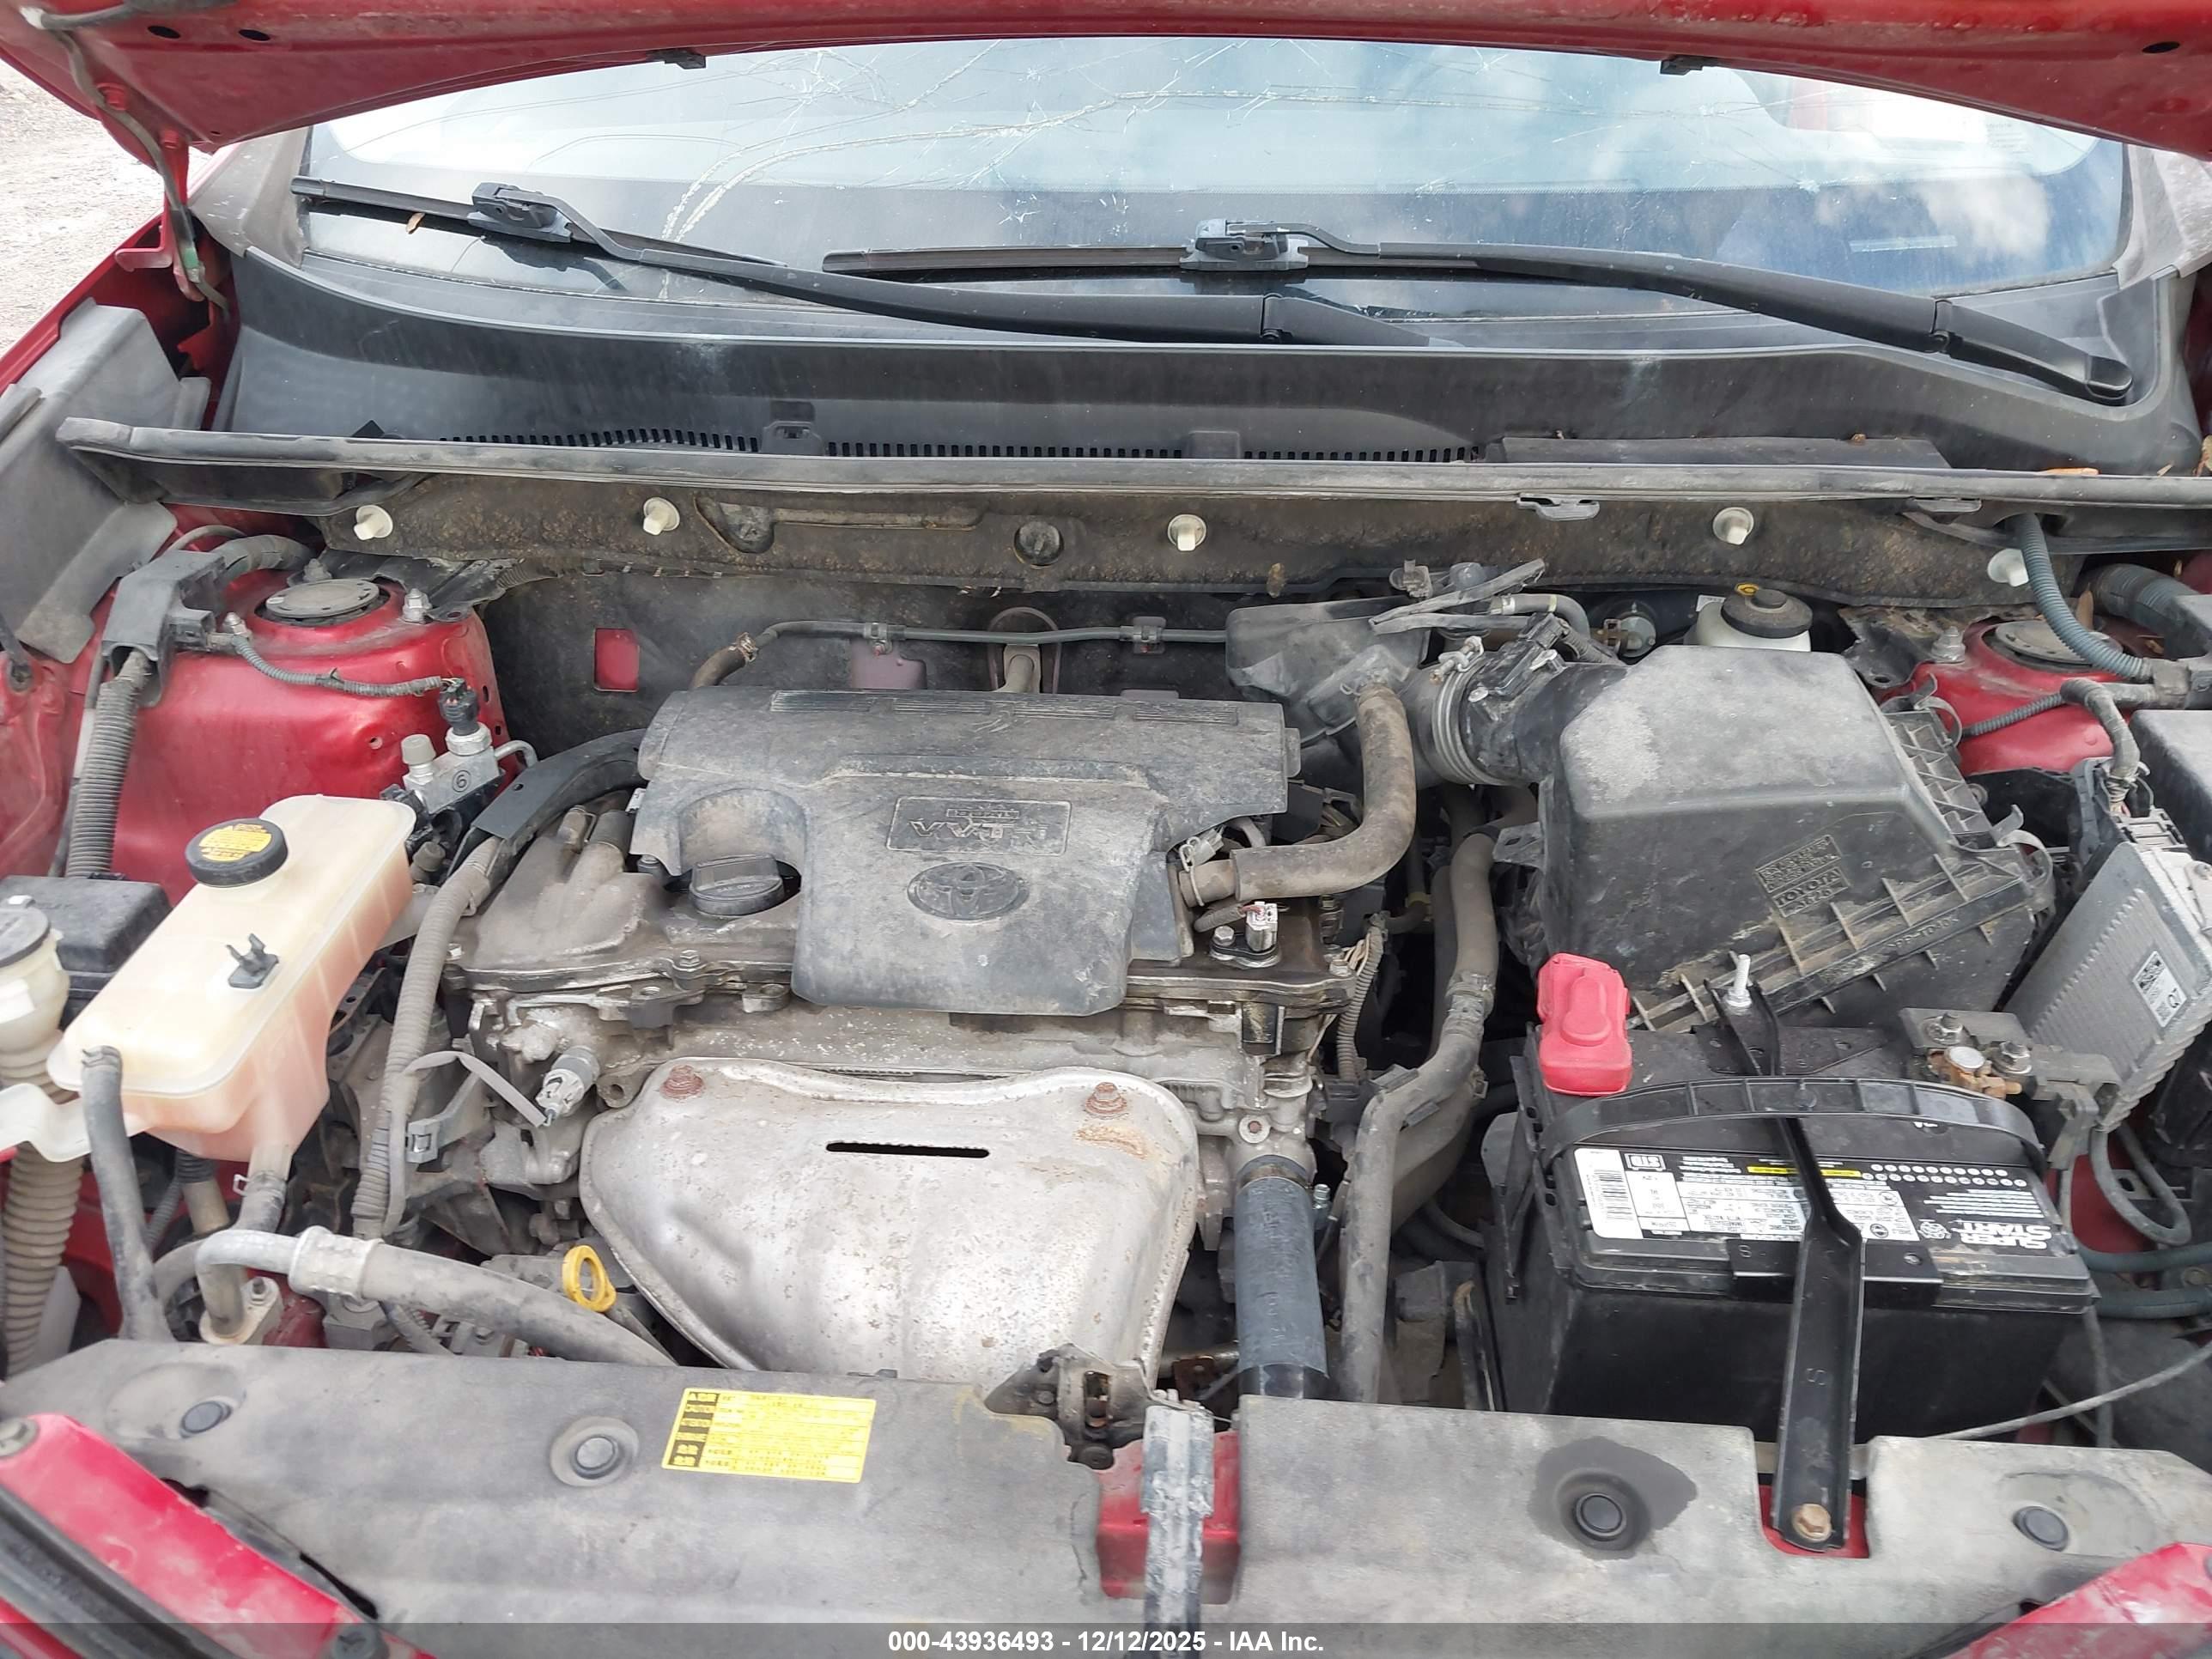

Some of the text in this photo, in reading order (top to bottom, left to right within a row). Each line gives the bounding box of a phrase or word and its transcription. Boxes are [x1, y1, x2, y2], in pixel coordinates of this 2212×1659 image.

[1776, 867, 1841, 906] TOYOTA
[1960, 1231, 2049, 1249] SUPER
[1961, 1221, 2053, 1242] START
